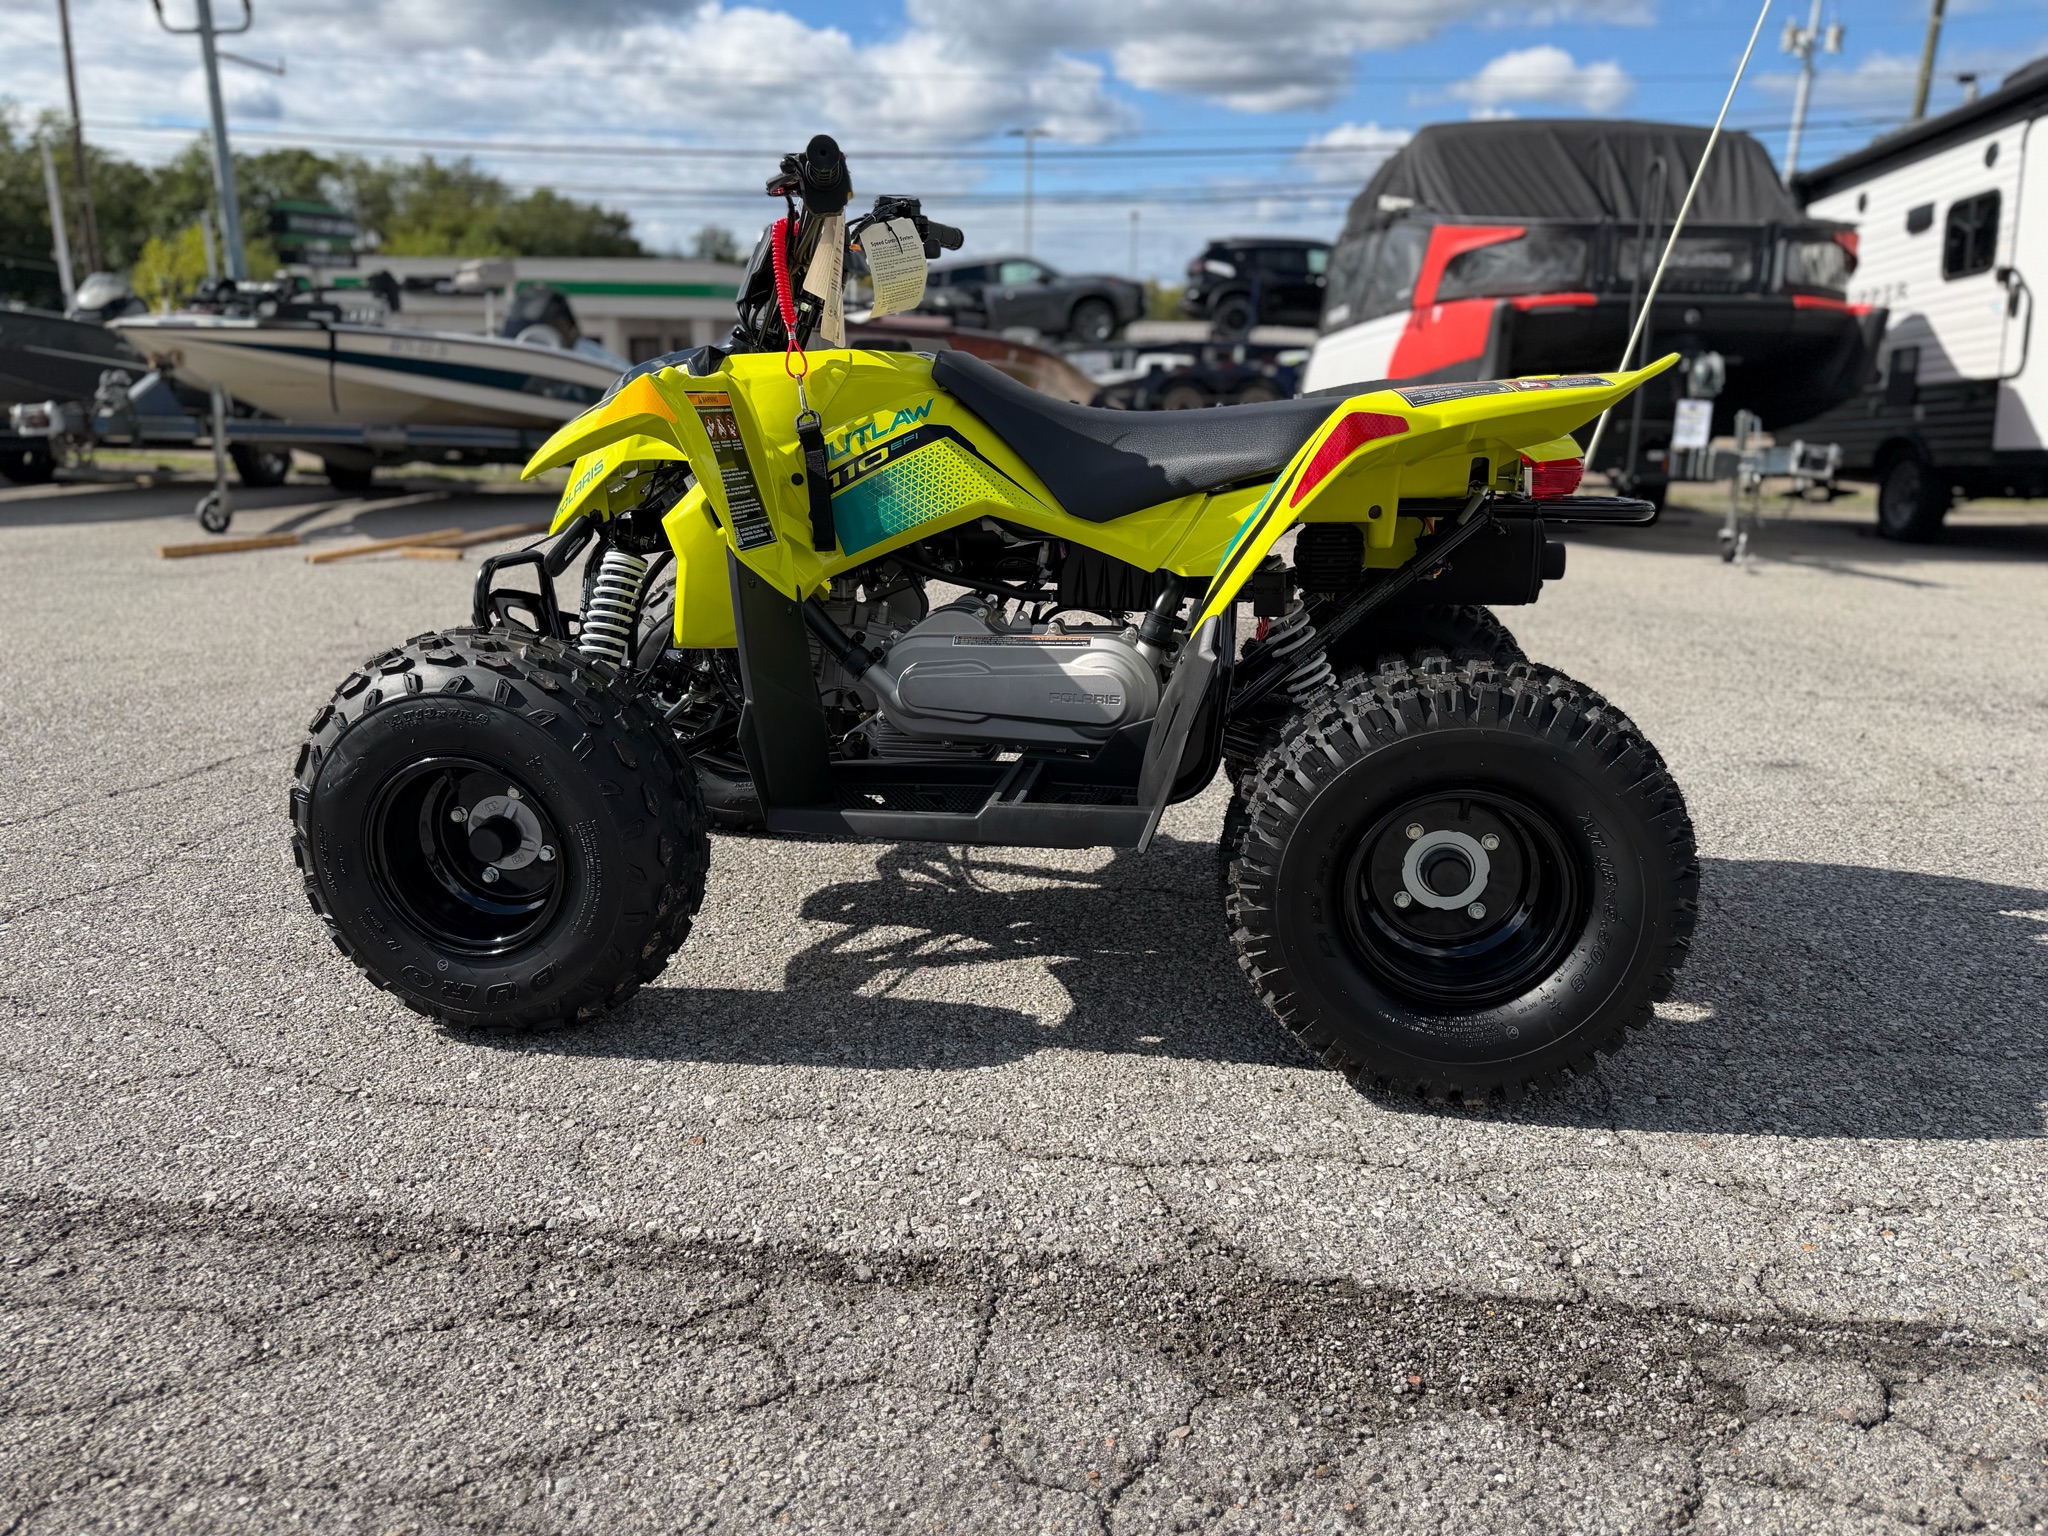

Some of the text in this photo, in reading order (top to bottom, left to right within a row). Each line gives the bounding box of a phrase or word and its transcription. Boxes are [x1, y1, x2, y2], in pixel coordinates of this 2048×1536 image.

[826, 398, 934, 462] UTLAW
[829, 432, 919, 488] 110 EFI
[1050, 692, 1121, 706] POLARIS
[401, 950, 557, 1005] DURO
